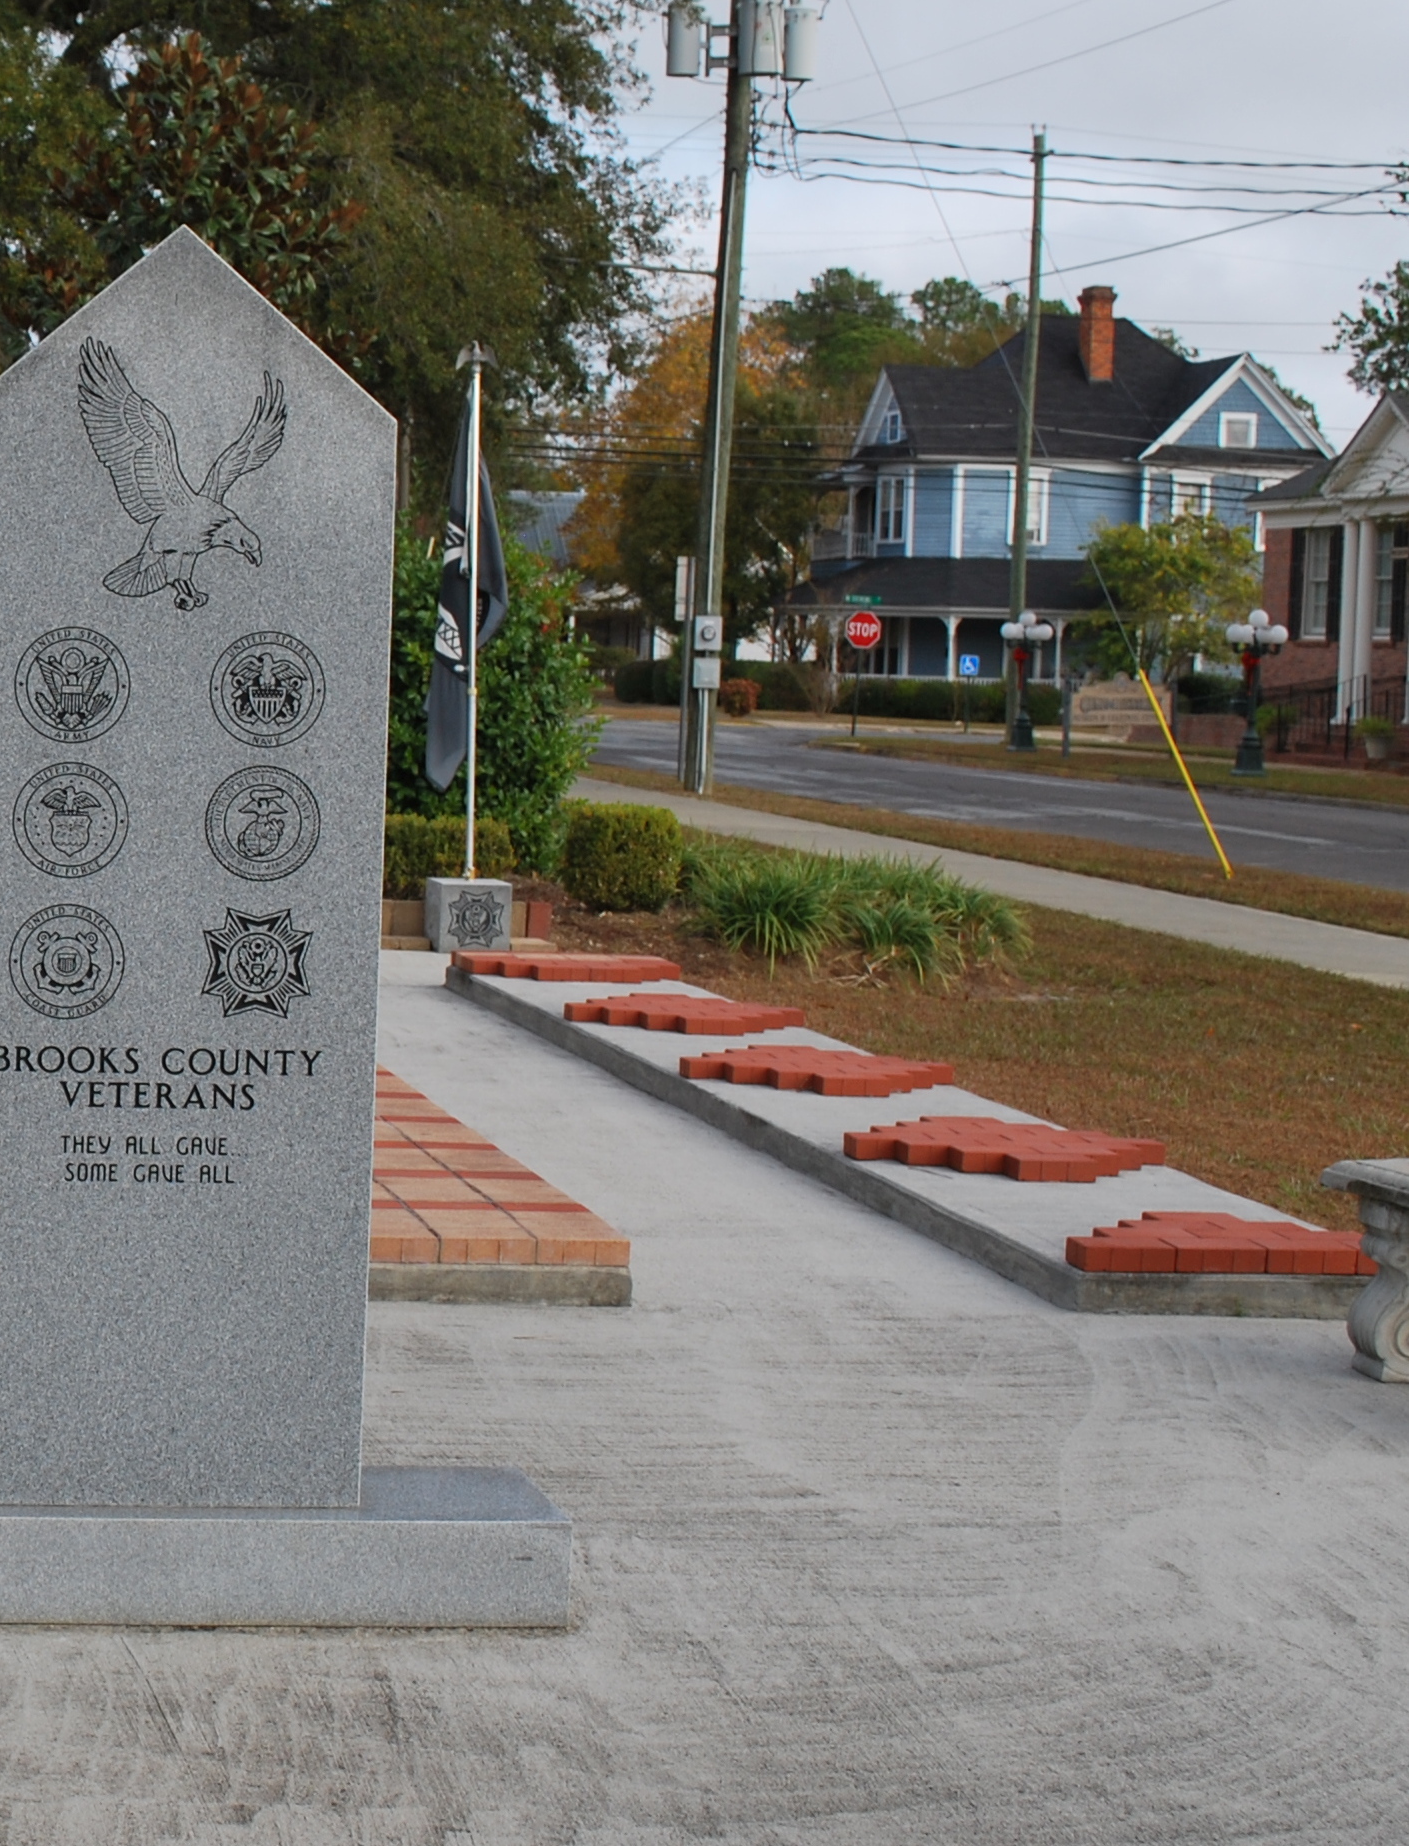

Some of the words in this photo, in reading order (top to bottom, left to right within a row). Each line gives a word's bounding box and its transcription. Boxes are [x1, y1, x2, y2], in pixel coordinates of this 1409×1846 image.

[848, 621, 878, 637] STOP
[31, 630, 71, 653] UNITED
[80, 630, 115, 655] STATES
[226, 634, 267, 658] UNITED
[276, 635, 311, 660] STATES
[54, 731, 90, 740] ARMY
[252, 736, 280, 745] NAVY
[28, 765, 70, 789] UNITED
[78, 765, 114, 791] STATES
[37, 860, 57, 872] AIR
[65, 860, 102, 876] FORCE
[25, 906, 66, 930] UNITED
[73, 906, 111, 932] STATES
[25, 993, 60, 1016] COAST
[68, 994, 106, 1017] GUARD
[161, 1048, 322, 1076] COUNTY
[59, 1081, 255, 1110] VETERANS
[61, 1135, 111, 1154] THEY
[125, 1136, 161, 1155] ALL
[64, 1163, 118, 1182] SOME
[133, 1164, 184, 1183] GAVE
